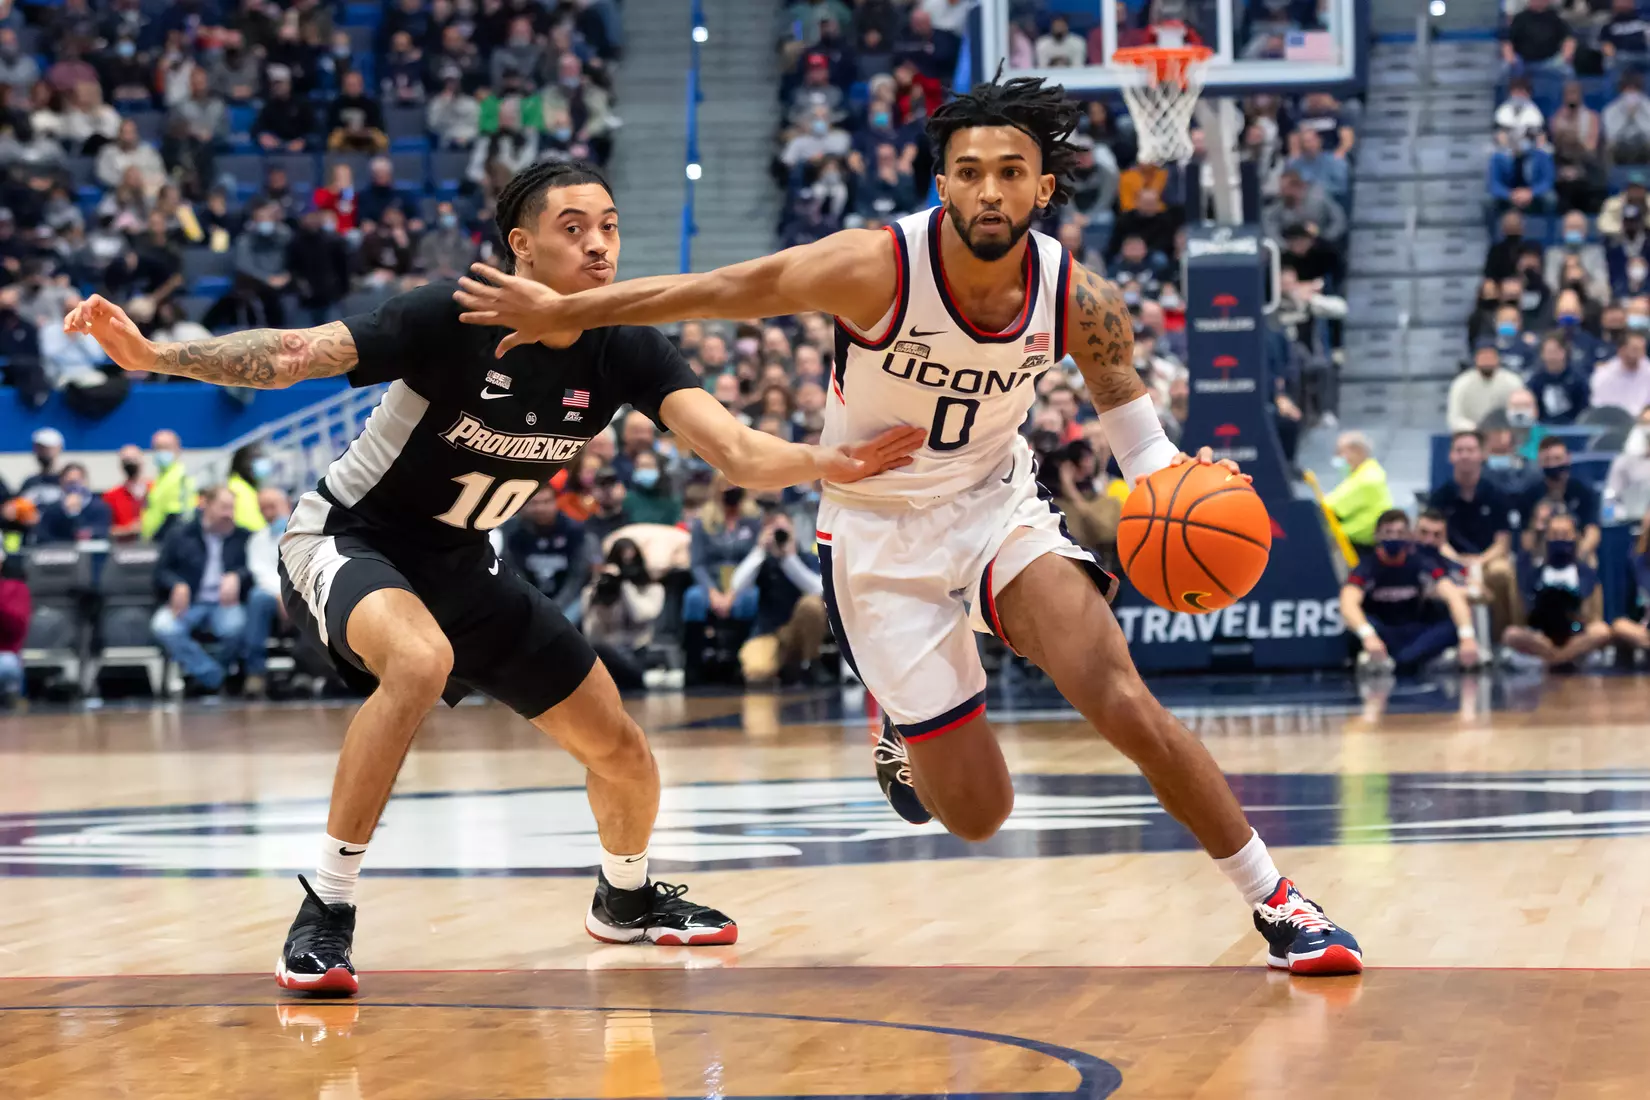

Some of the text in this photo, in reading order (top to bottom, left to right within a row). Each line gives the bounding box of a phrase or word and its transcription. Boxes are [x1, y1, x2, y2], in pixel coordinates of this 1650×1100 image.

[444, 415, 587, 461] PROVIDENCE
[928, 395, 981, 451] 0
[433, 470, 540, 531] 10
[1117, 596, 1346, 643] TRAVELERS
